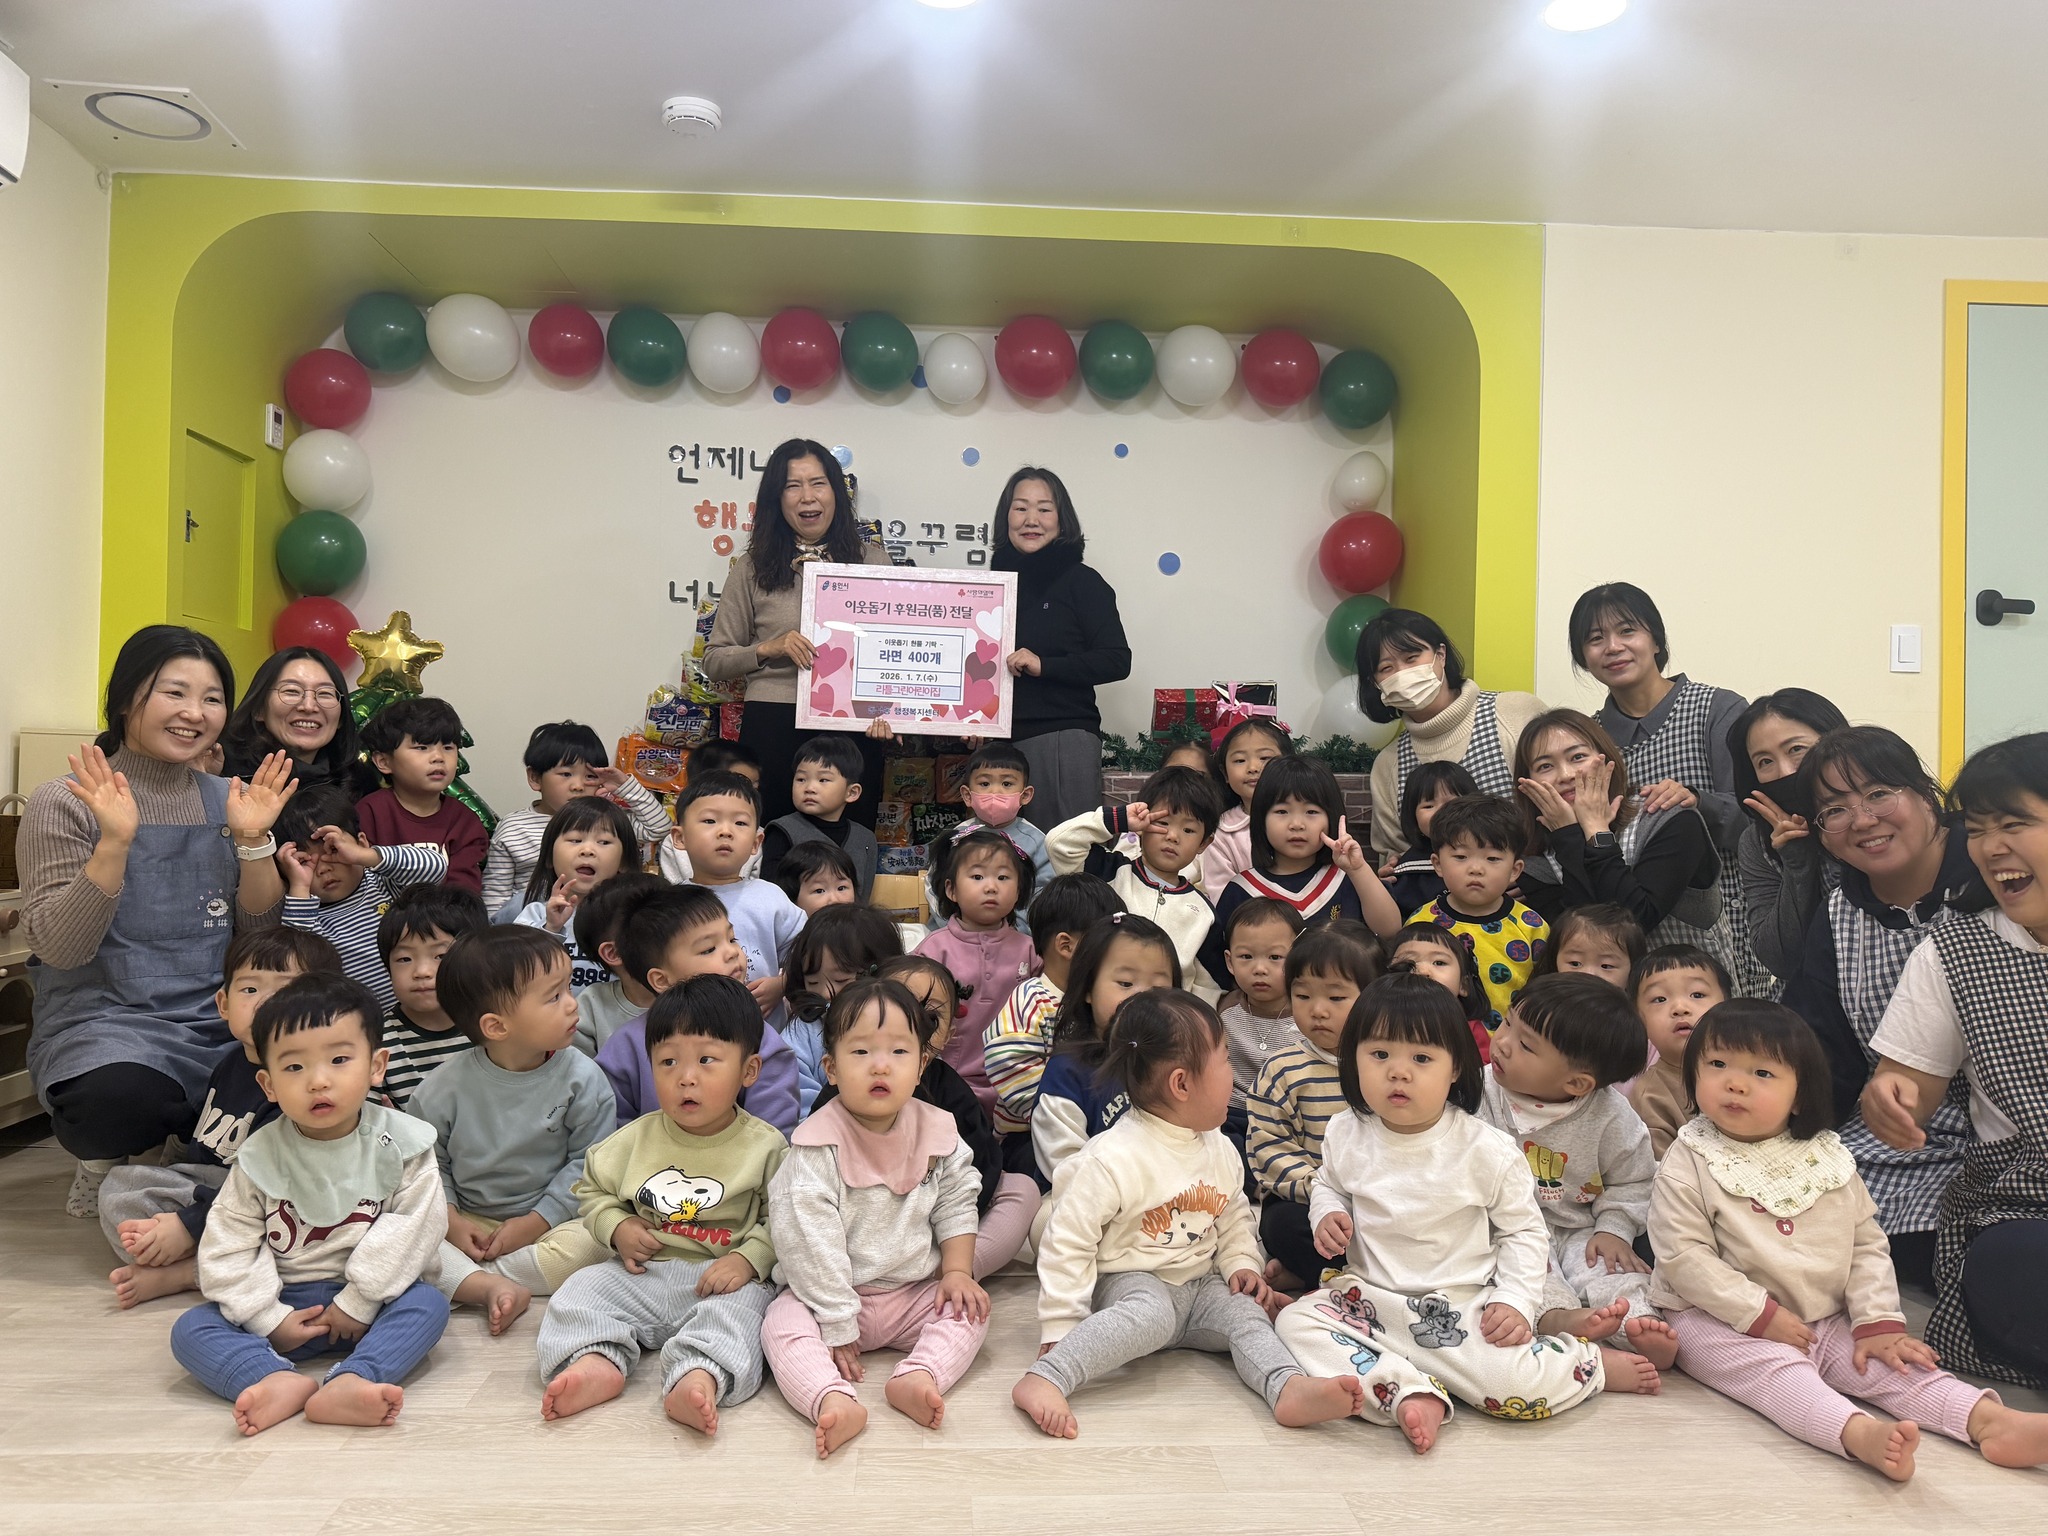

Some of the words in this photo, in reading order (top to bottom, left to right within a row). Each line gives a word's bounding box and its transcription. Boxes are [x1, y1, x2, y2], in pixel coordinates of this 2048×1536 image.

[831, 582, 849, 591] 용인시
[845, 600, 891, 615] 이웃돕기
[893, 603, 947, 619] 후원금(품)
[949, 605, 974, 619] 전달
[884, 639, 909, 647] 이웃돕기
[879, 650, 903, 663] 라면
[908, 652, 942, 665] 400개
[880, 672, 903, 681] 2026.
[893, 707, 940, 717] 행정복지센터
[655, 713, 702, 732] 진라면
[636, 748, 682, 760] 삼양라면
